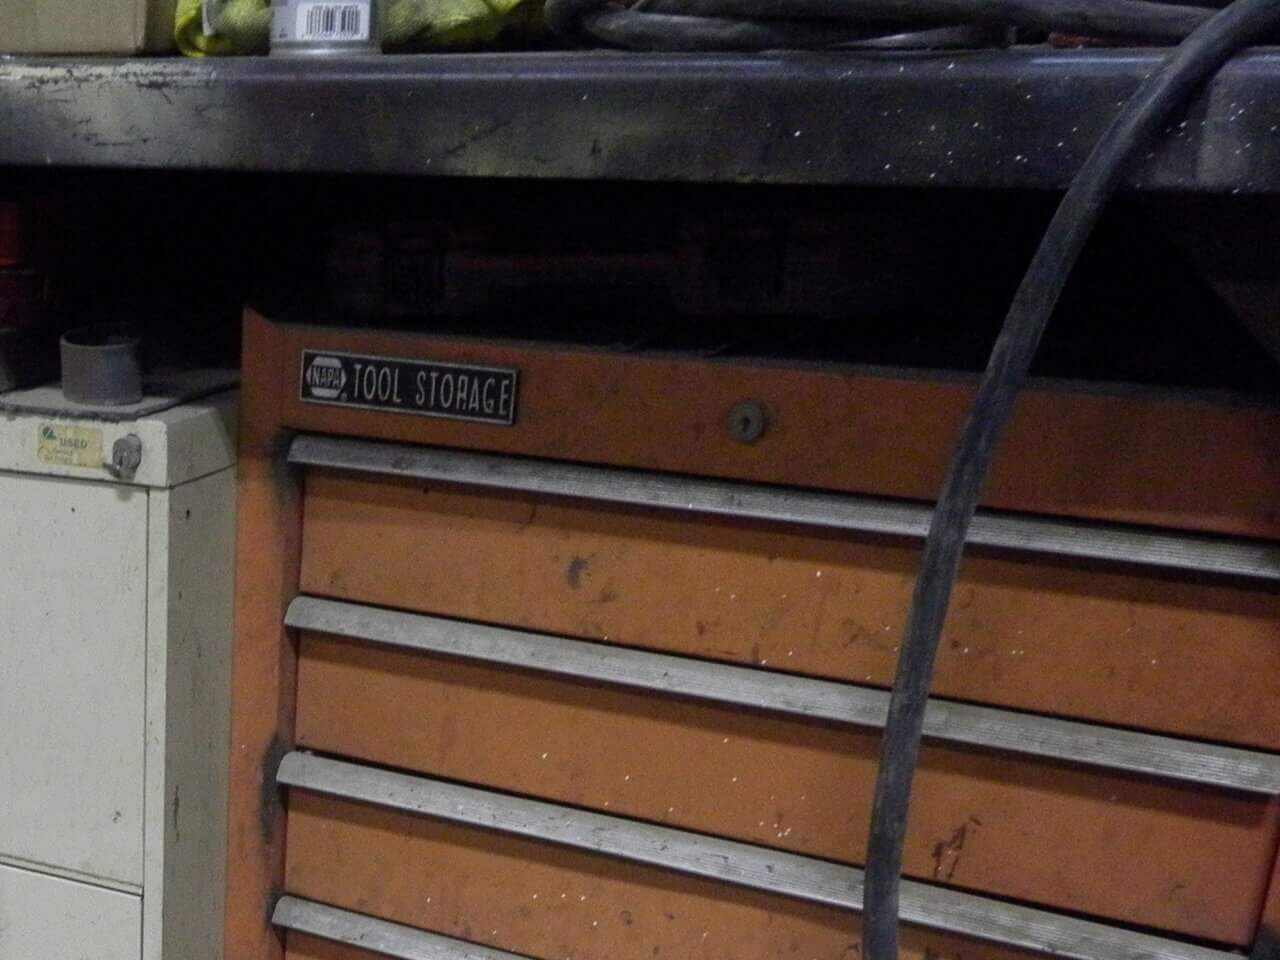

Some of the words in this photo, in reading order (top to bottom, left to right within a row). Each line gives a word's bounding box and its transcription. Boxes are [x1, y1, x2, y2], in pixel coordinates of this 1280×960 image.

[311, 365, 342, 389] NAPA
[352, 363, 402, 403] TOOL
[415, 370, 510, 416] STORAGE
